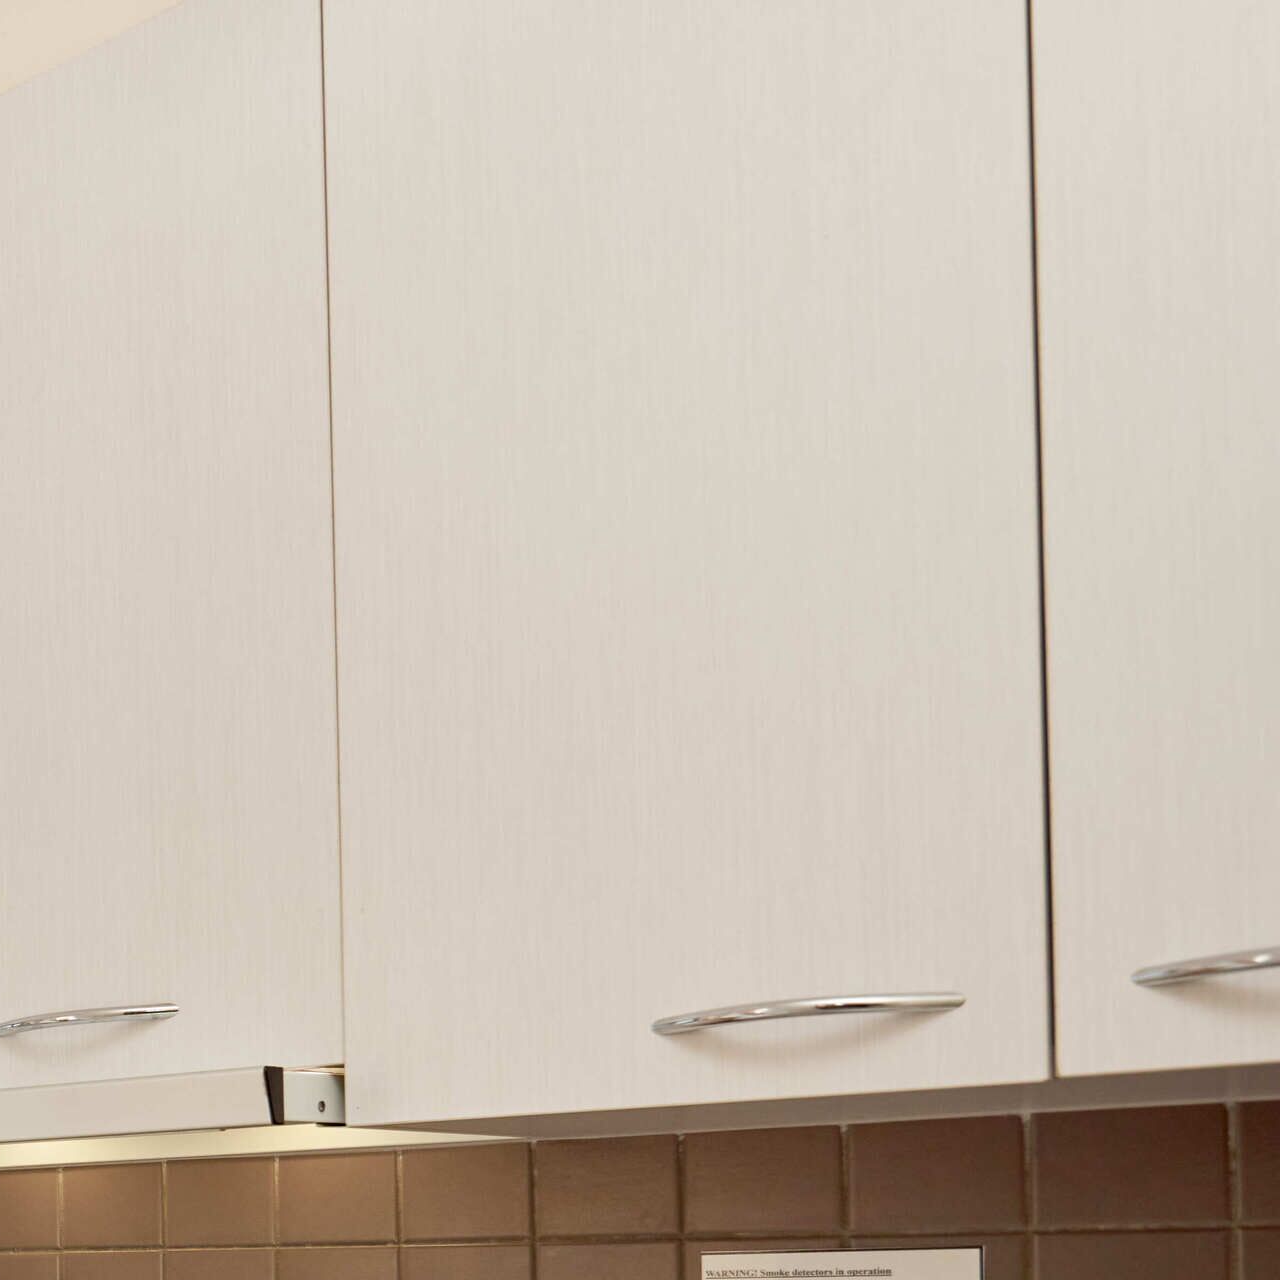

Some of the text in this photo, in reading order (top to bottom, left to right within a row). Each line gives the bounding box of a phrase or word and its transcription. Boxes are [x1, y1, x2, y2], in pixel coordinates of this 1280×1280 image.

[705, 1266, 892, 1279] WARNING! Smoke detectors in operation
